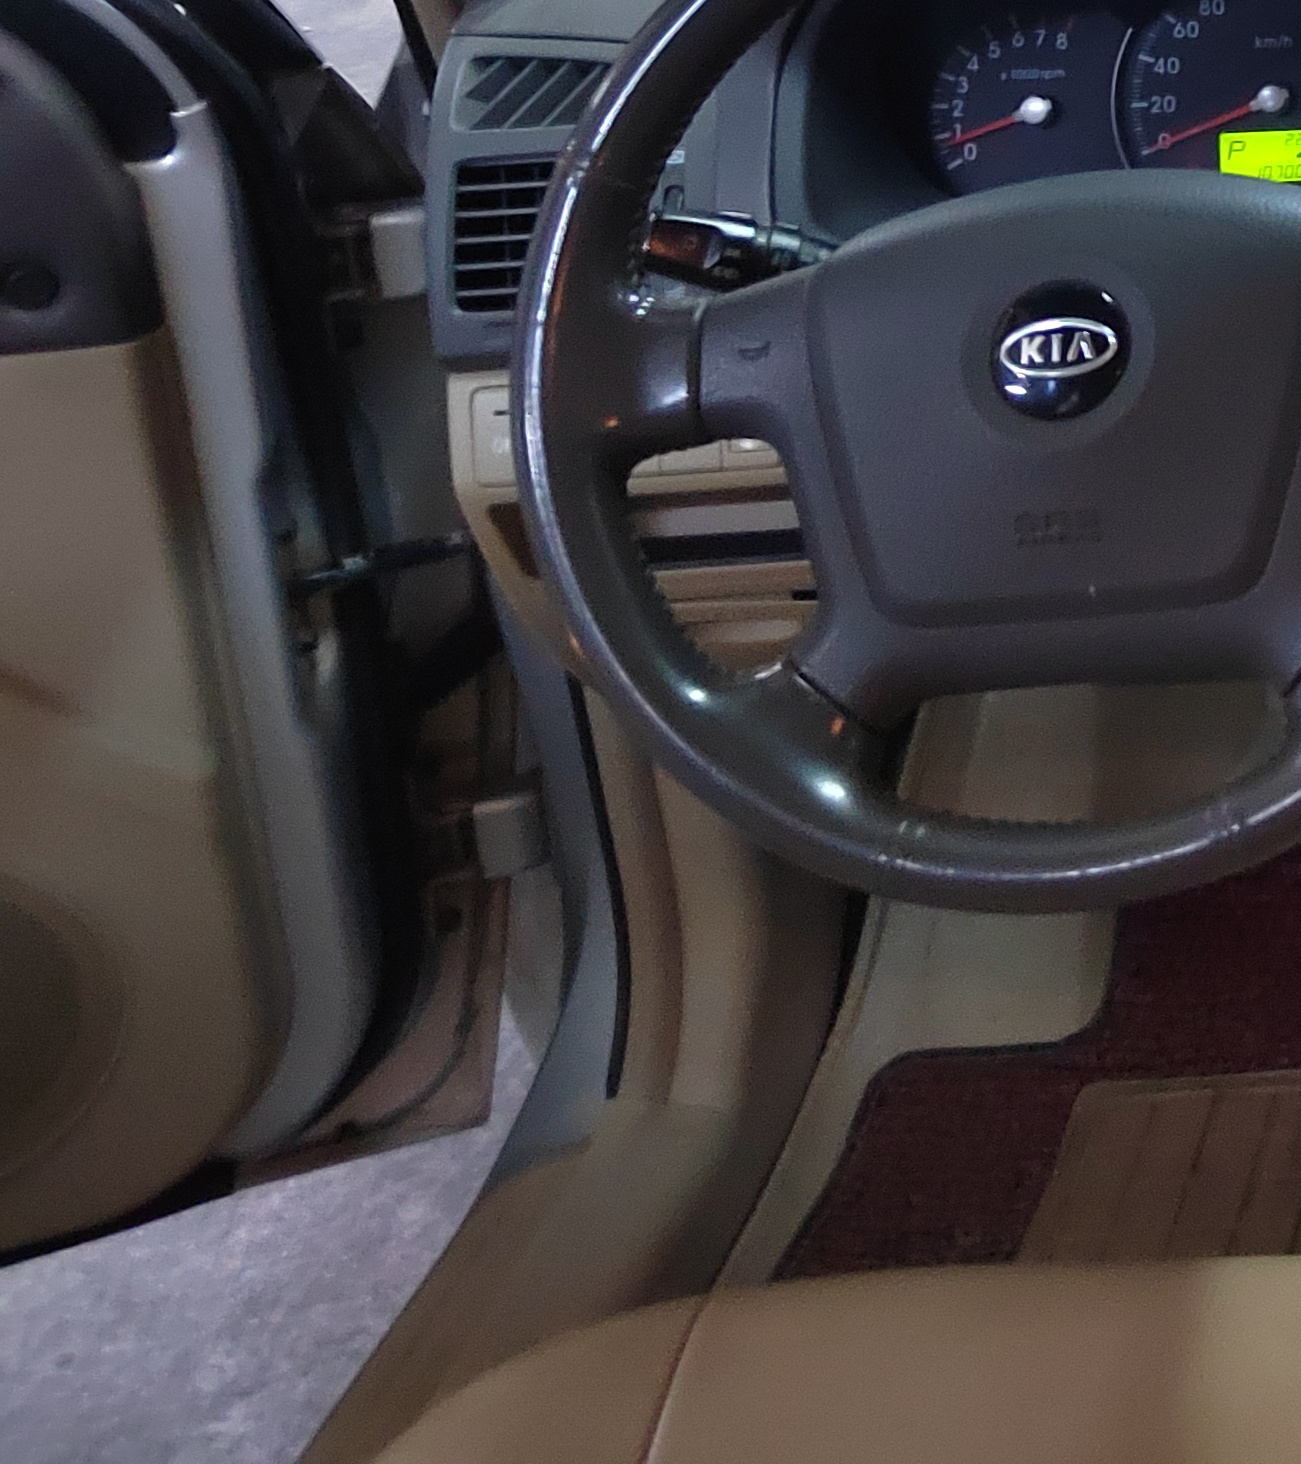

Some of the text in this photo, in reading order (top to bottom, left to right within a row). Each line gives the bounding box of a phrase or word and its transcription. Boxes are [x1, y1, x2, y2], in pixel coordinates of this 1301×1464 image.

[1199, 0, 1225, 16] 80
[1173, 21, 1200, 38] 60
[1012, 31, 1025, 47] 6
[1034, 29, 1046, 48] 7
[1055, 33, 1068, 50] 8
[988, 40, 1000, 58] 5
[967, 56, 979, 71] 4
[1154, 57, 1180, 74] 40
[957, 76, 968, 93] 3
[952, 100, 964, 117] 2
[1150, 96, 1176, 113] 20
[964, 142, 977, 160] 0
[1228, 140, 1247, 160] P
[1019, 331, 1096, 365] KIA
